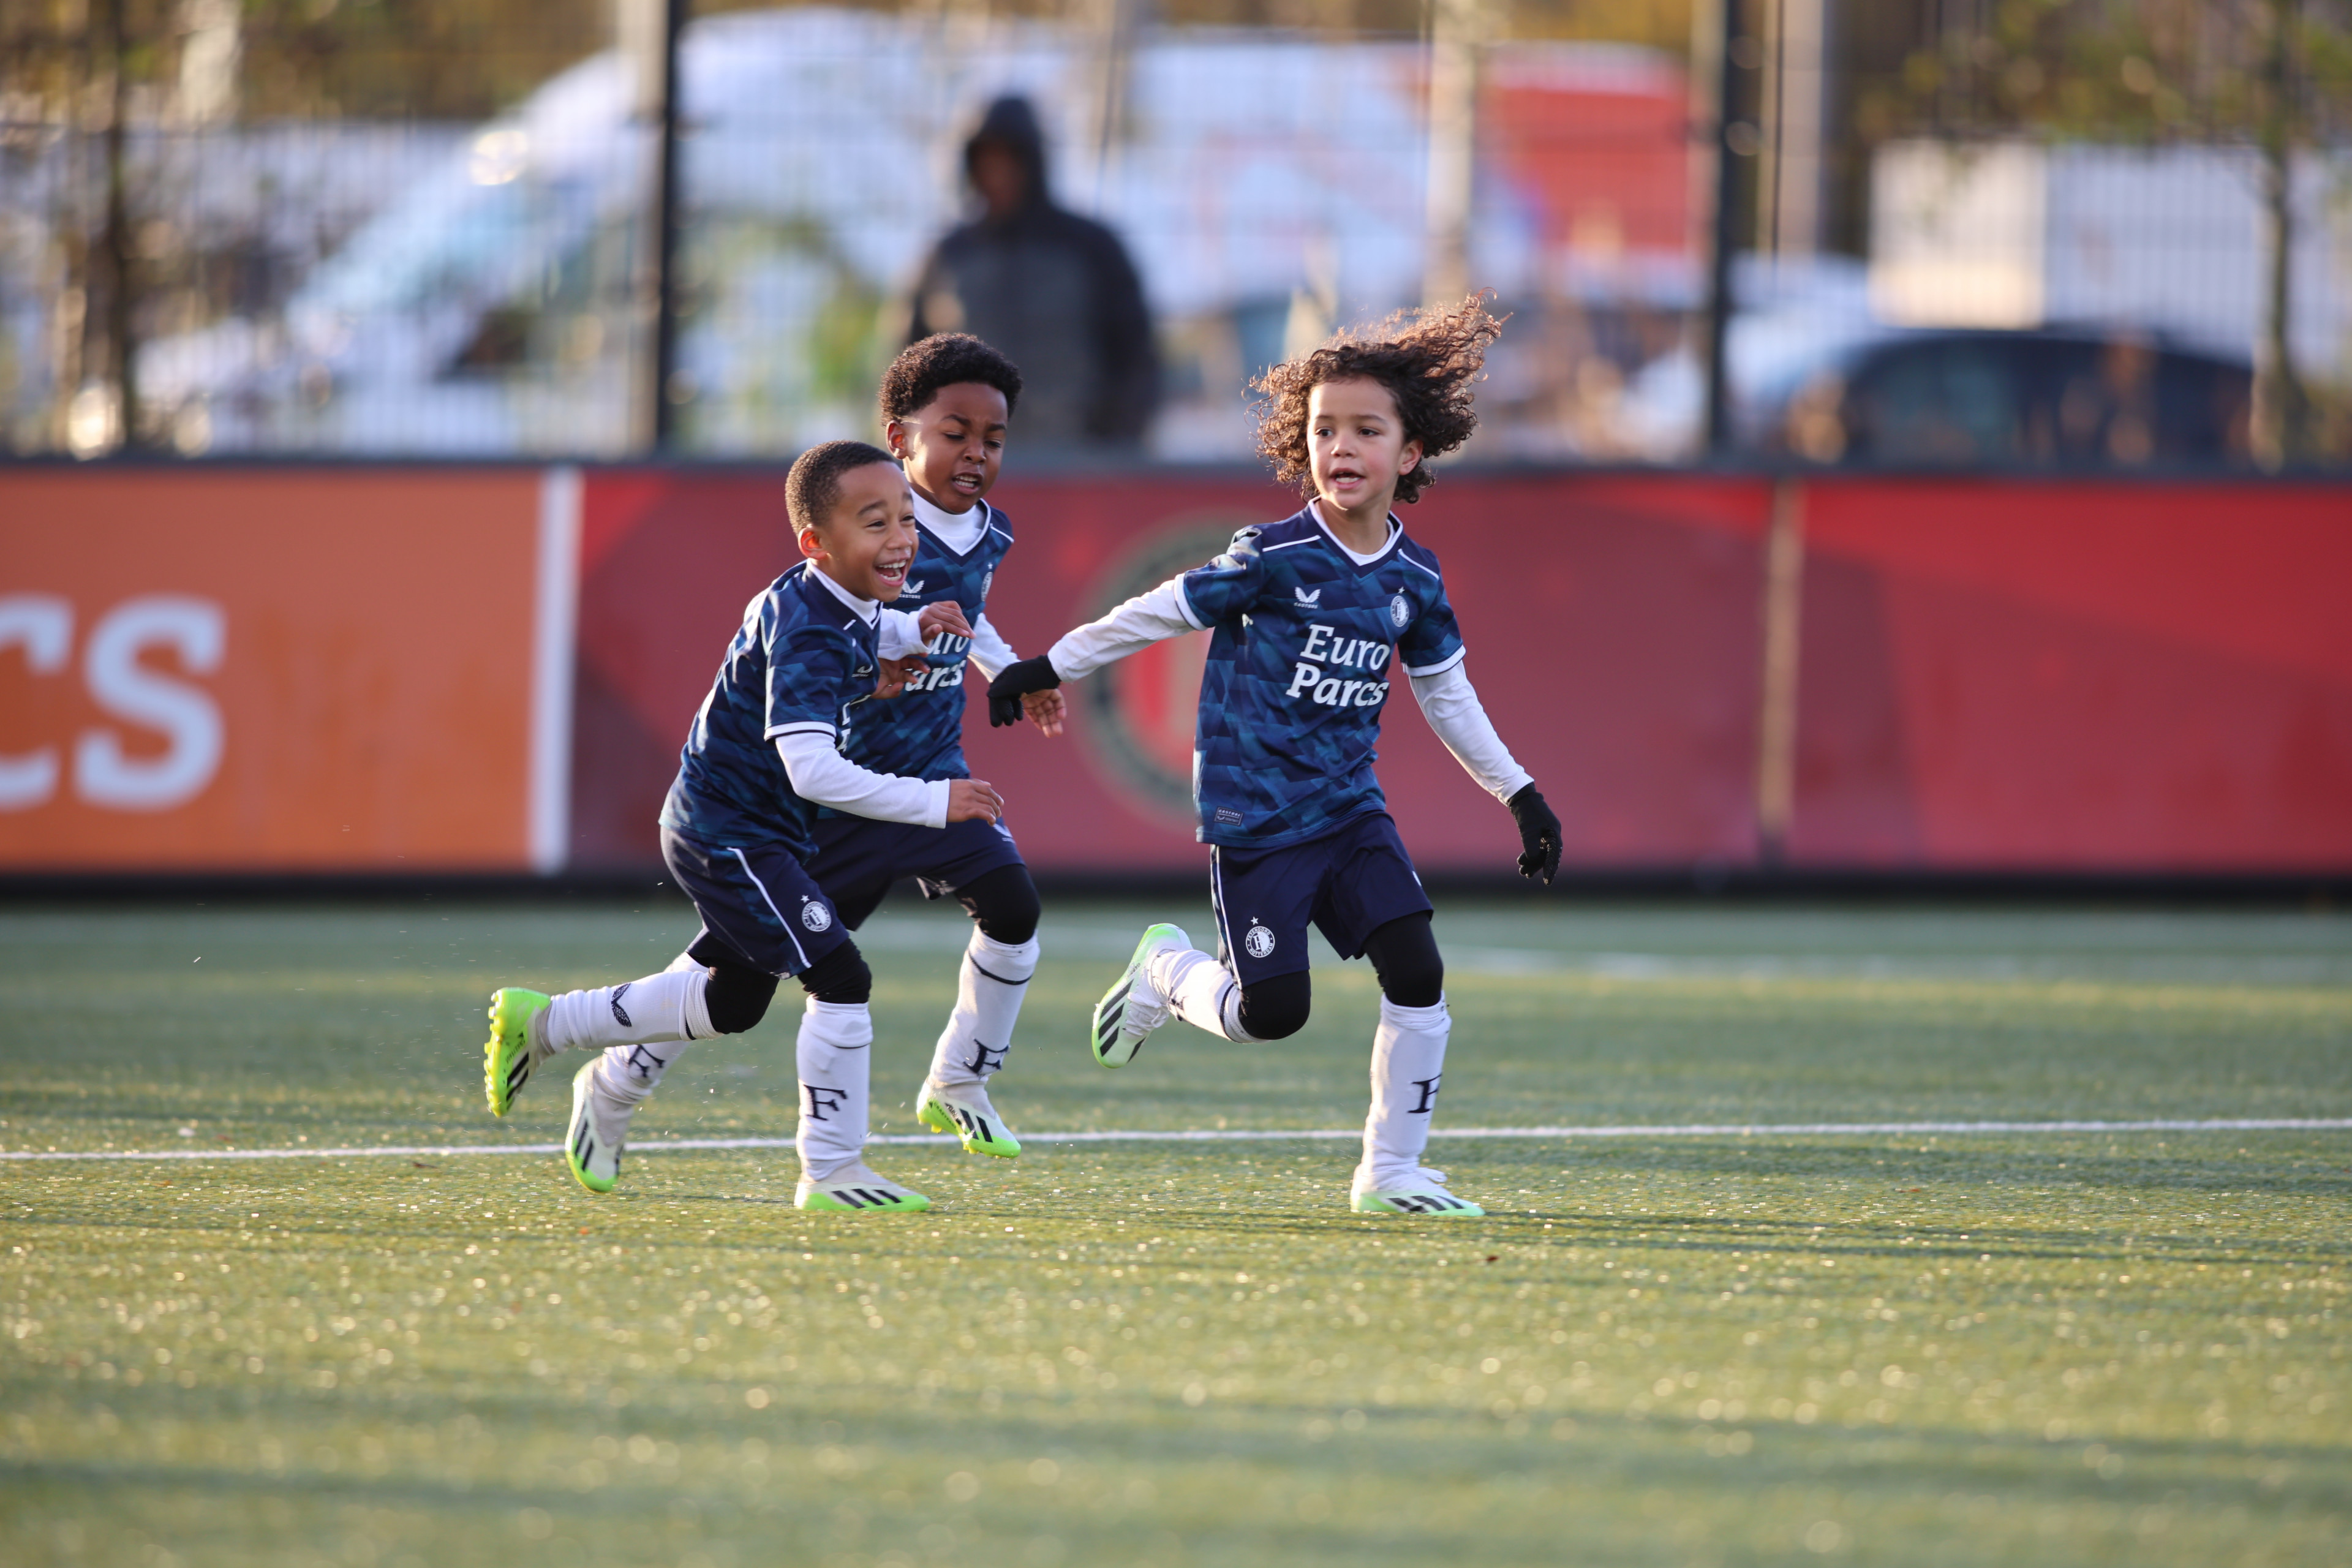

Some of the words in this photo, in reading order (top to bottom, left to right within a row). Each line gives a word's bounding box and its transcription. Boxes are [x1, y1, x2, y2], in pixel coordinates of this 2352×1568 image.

[1299, 624, 1390, 670] Euro
[905, 660, 967, 692] arcs
[1286, 662, 1390, 707] Parcs
[1247, 927, 1270, 941] FEYENOORD
[1250, 943, 1273, 956] ROTTERDAM
[963, 1038, 1009, 1076] F
[803, 1084, 848, 1121] F
